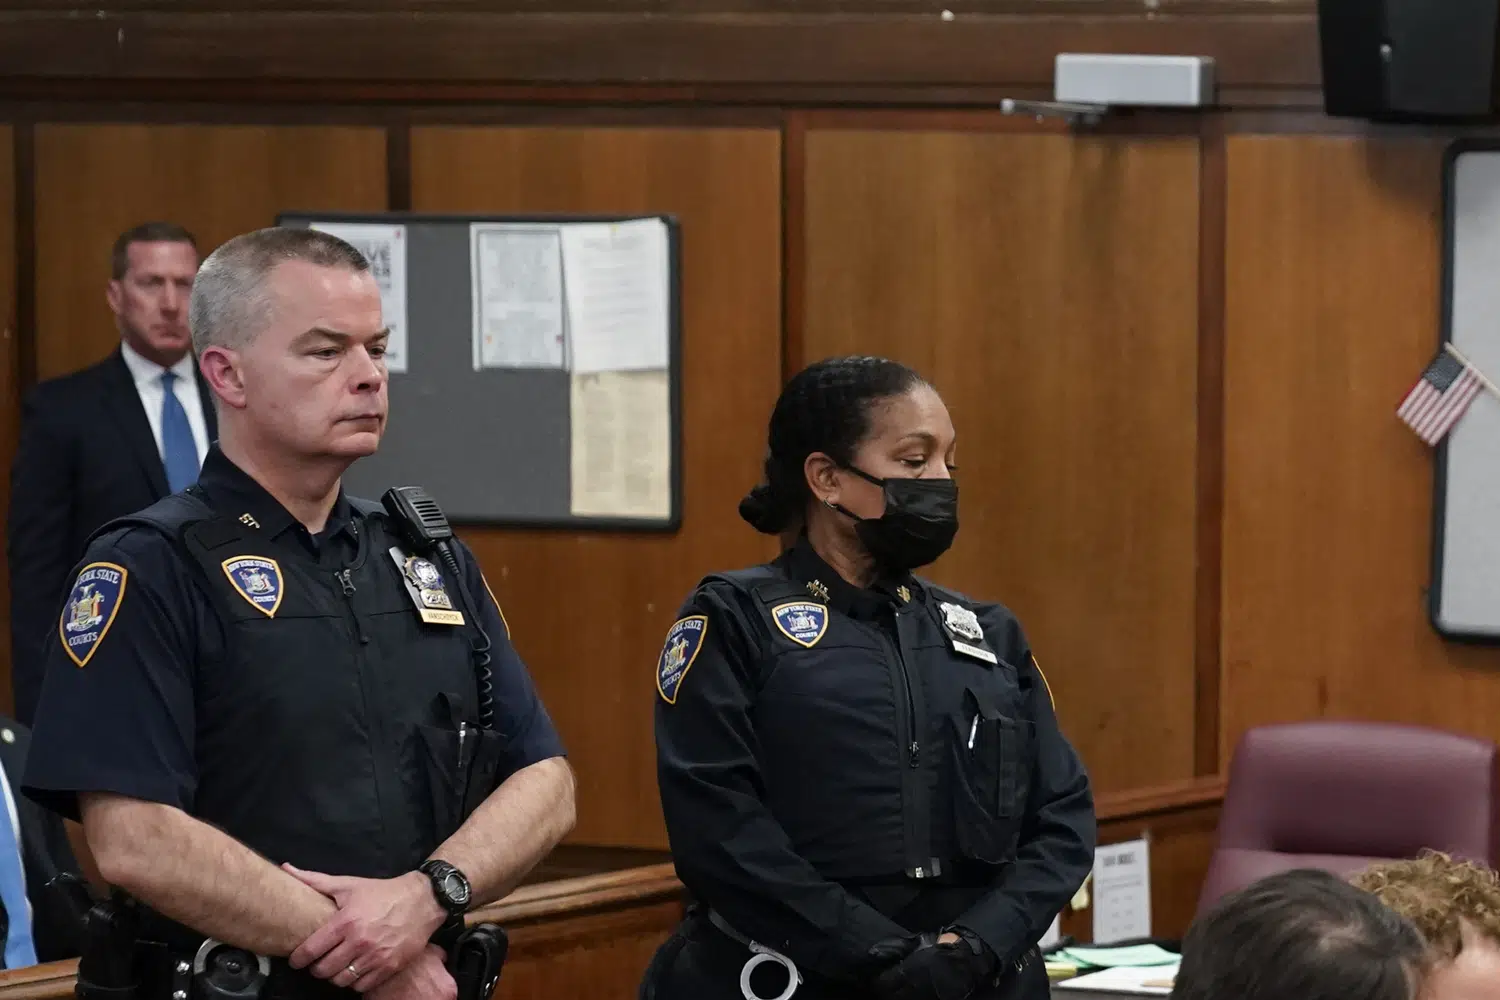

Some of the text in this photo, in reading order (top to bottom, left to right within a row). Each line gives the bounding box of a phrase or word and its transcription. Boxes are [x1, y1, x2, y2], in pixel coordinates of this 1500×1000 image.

[96, 569, 118, 584] STATE
[777, 605, 822, 617] NEW YORK STATE
[684, 620, 703, 631] STATE
[69, 632, 98, 646] COURTS
[662, 671, 681, 690] COURTS
